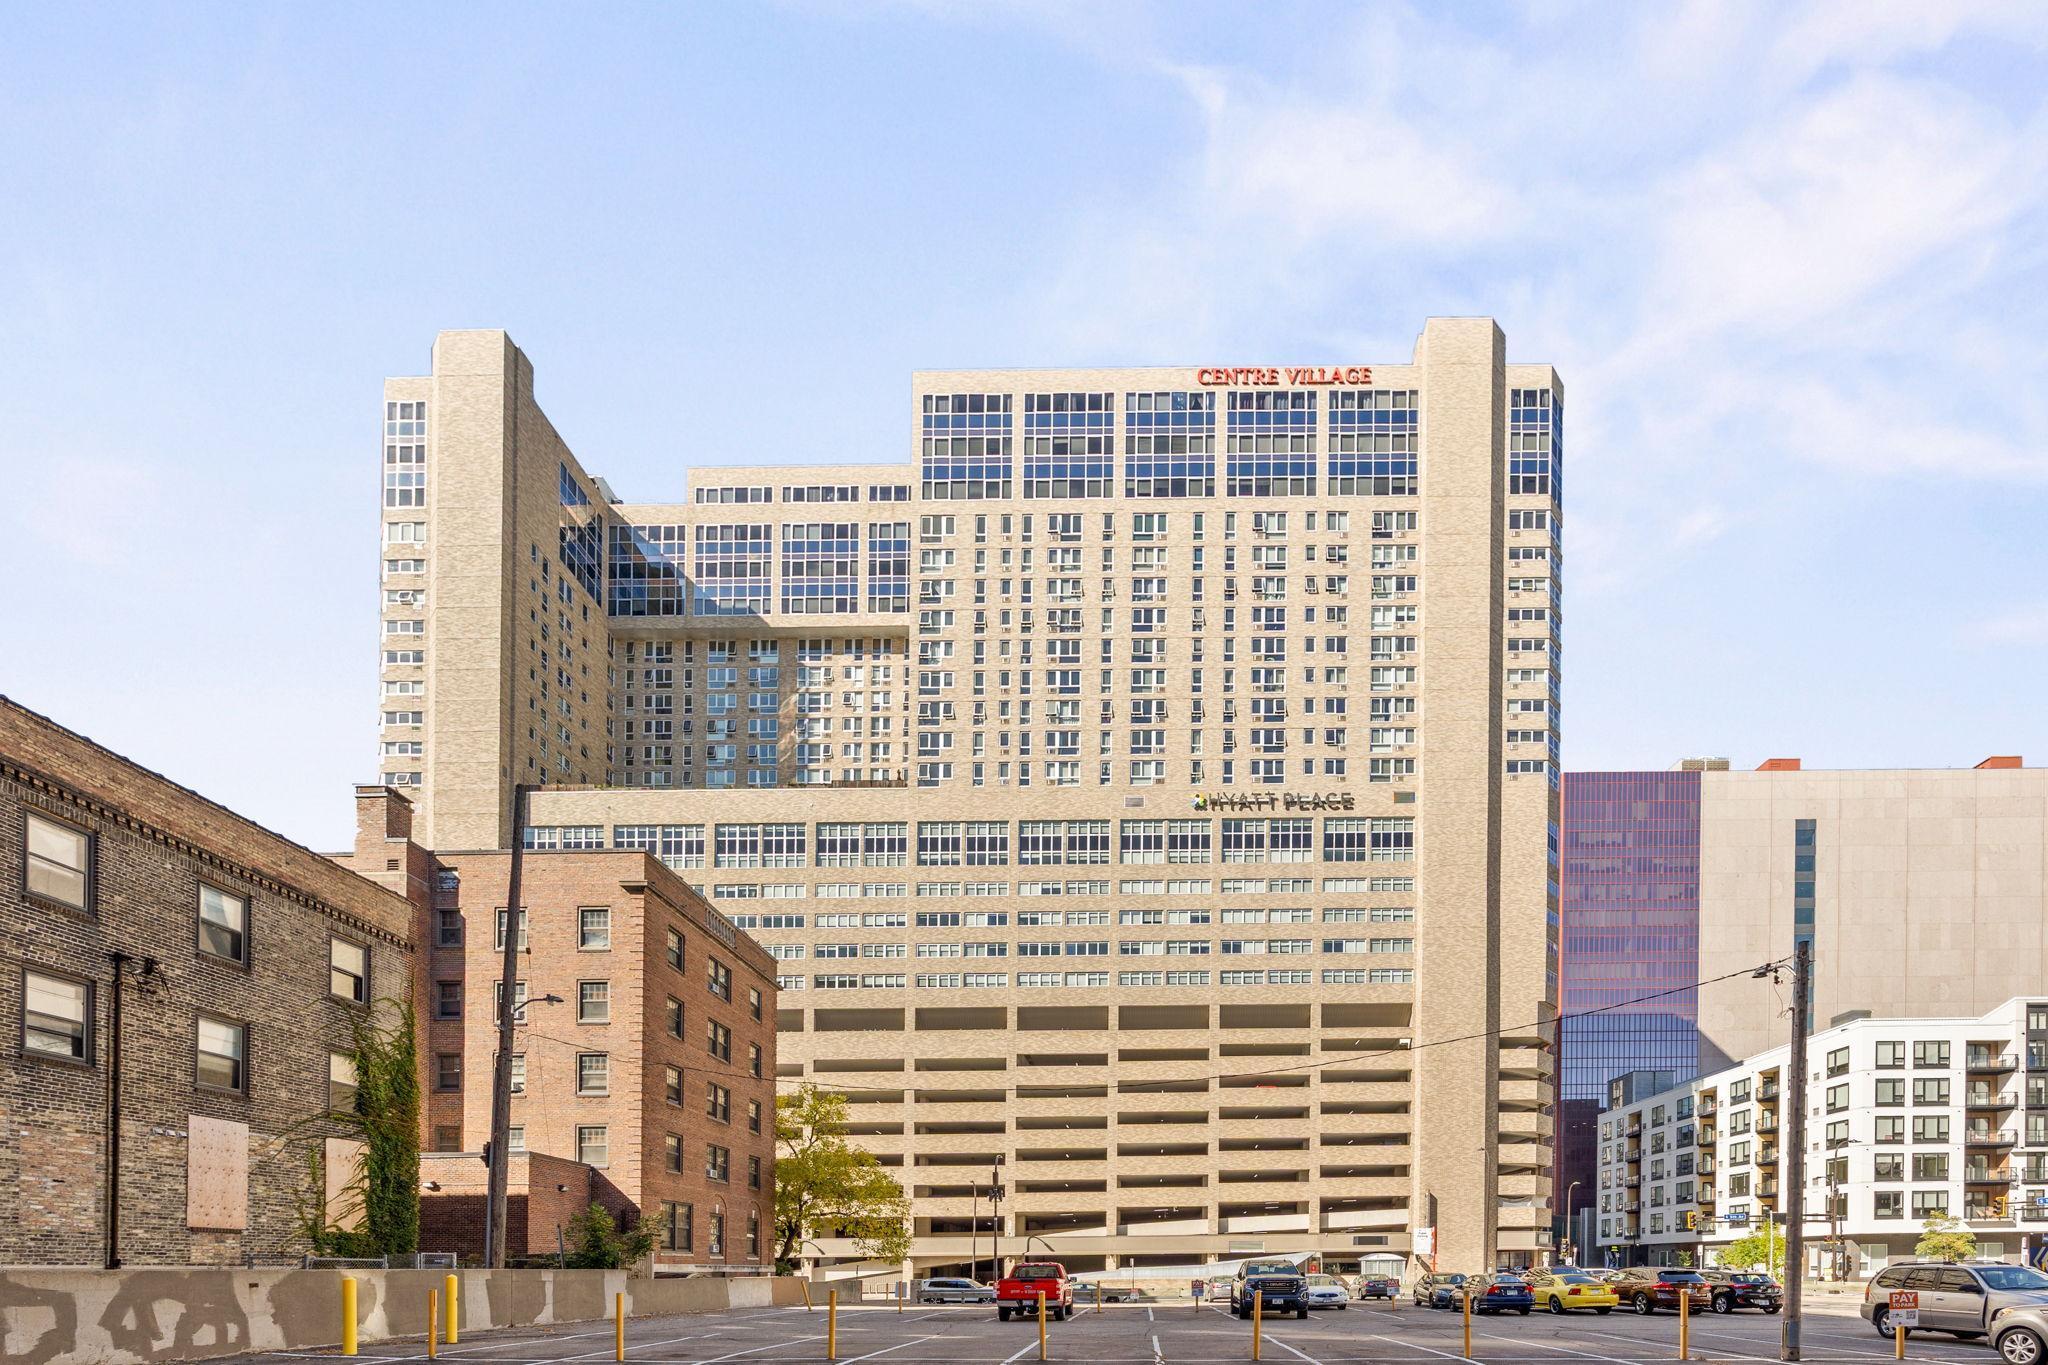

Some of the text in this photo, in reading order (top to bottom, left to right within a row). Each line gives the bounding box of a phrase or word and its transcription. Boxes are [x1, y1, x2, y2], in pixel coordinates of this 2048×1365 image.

[1197, 367, 1372, 385] CENTRE VILLAGE
[1208, 791, 1354, 810] HYATT PLACE
[1892, 1293, 1915, 1302] PAY
